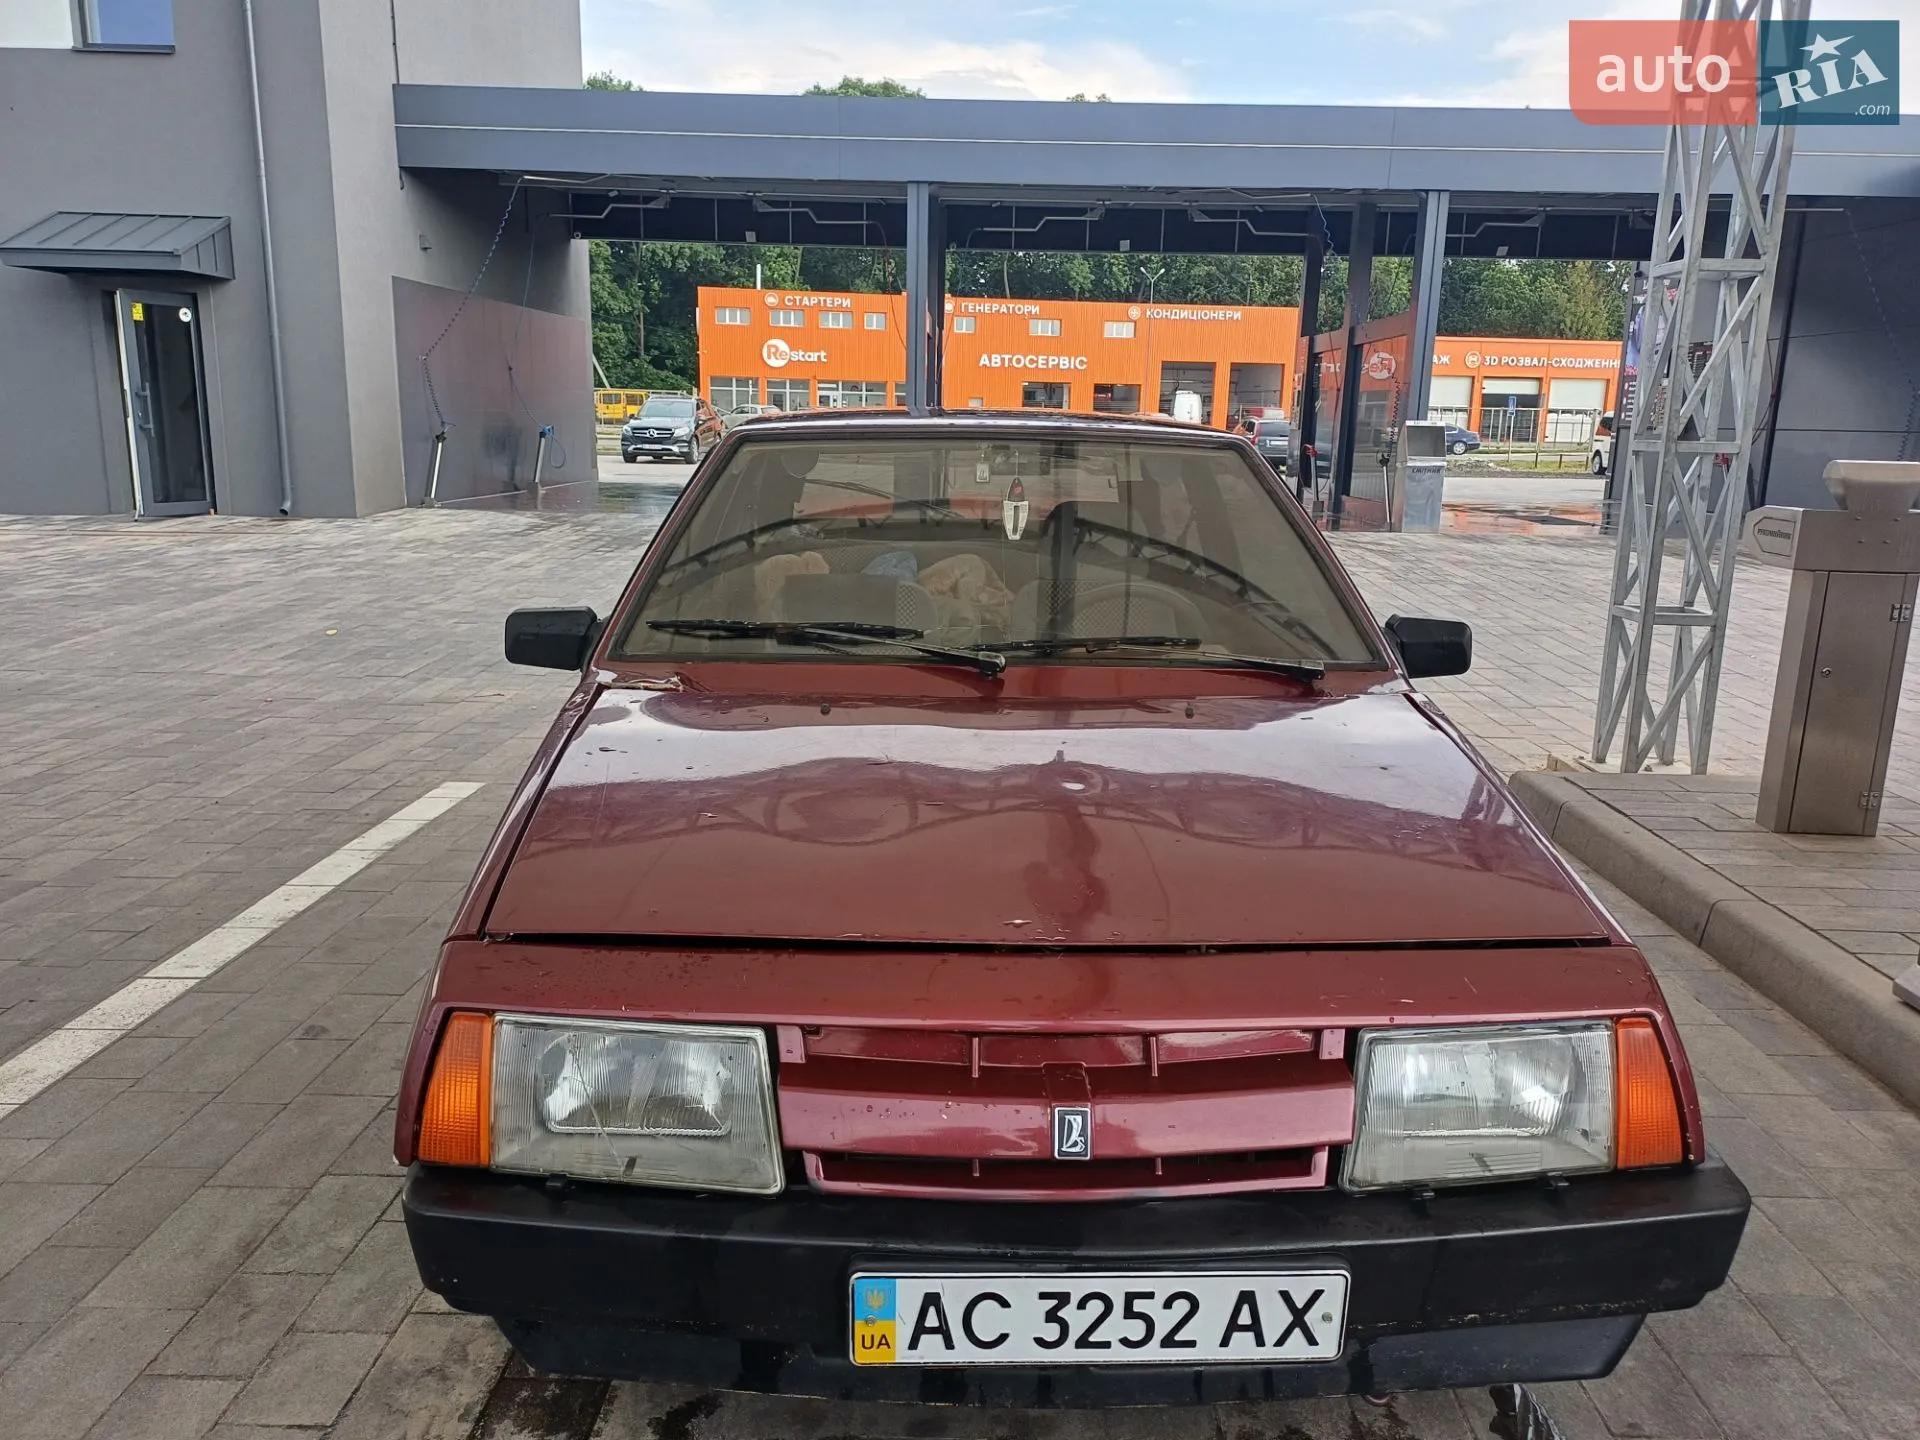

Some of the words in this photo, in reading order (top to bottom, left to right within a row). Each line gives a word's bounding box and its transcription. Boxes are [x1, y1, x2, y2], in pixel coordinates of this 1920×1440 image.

[784, 295, 852, 308] СТАРТЕРИ
[961, 302, 1041, 315] ГЕНЕРАТОРИ
[1146, 309, 1242, 321] КОНДИЦІОНЕРИ
[763, 341, 828, 365] Restart
[978, 353, 1088, 370] АВТОСЕРВІС
[1484, 356, 1498, 367] 3D
[907, 1290, 1012, 1351] AC
[1032, 1289, 1200, 1349] 3252
[1218, 1288, 1326, 1348] AX
[861, 1333, 892, 1351] UA
